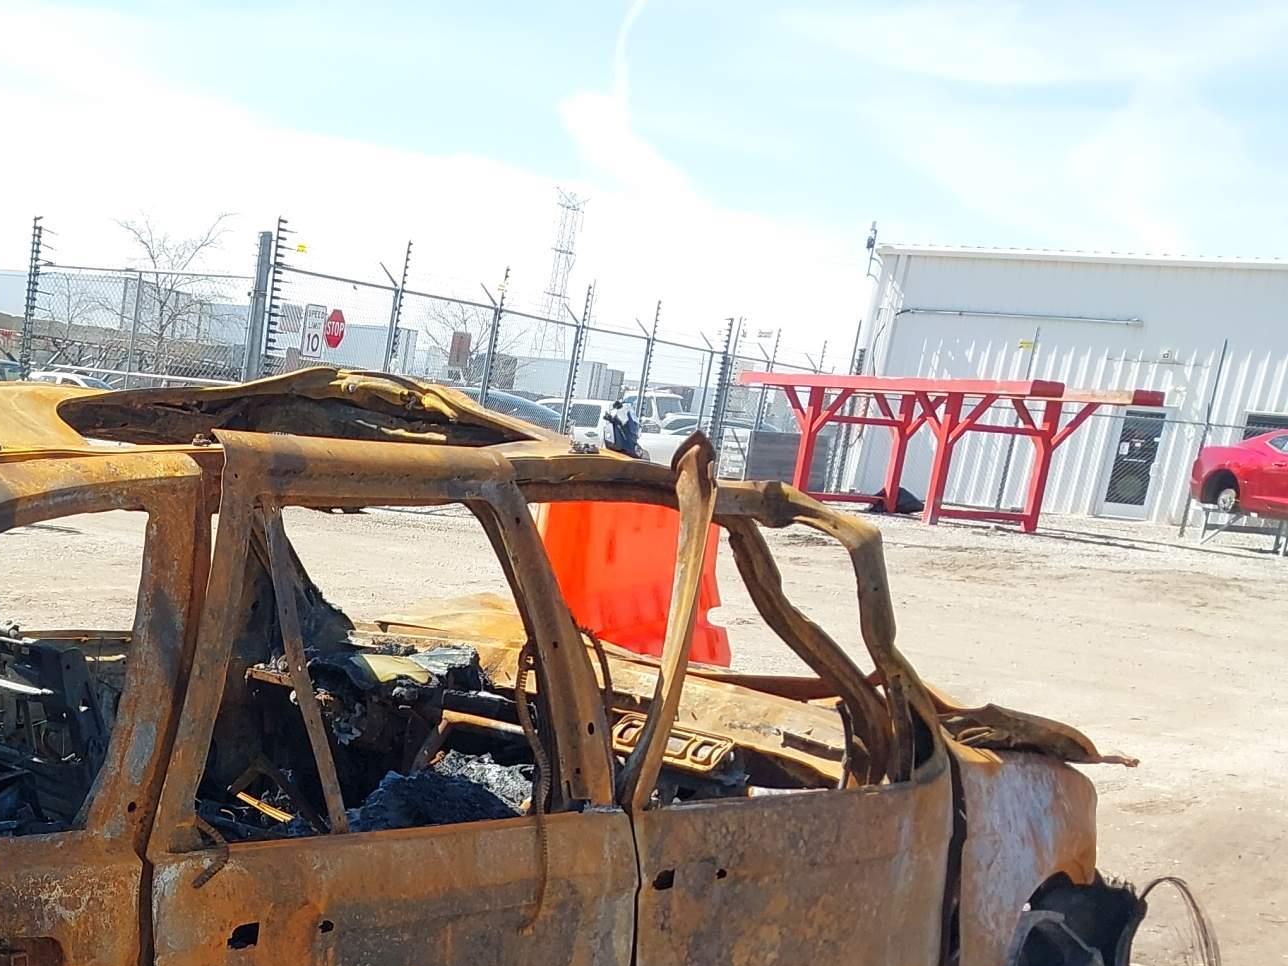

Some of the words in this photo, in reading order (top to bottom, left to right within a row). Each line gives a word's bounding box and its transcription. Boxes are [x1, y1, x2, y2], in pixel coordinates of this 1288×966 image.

[308, 310, 325, 319] SPEED
[308, 322, 322, 330] LIMIT
[327, 321, 344, 337] STOP
[307, 333, 319, 352] 10
